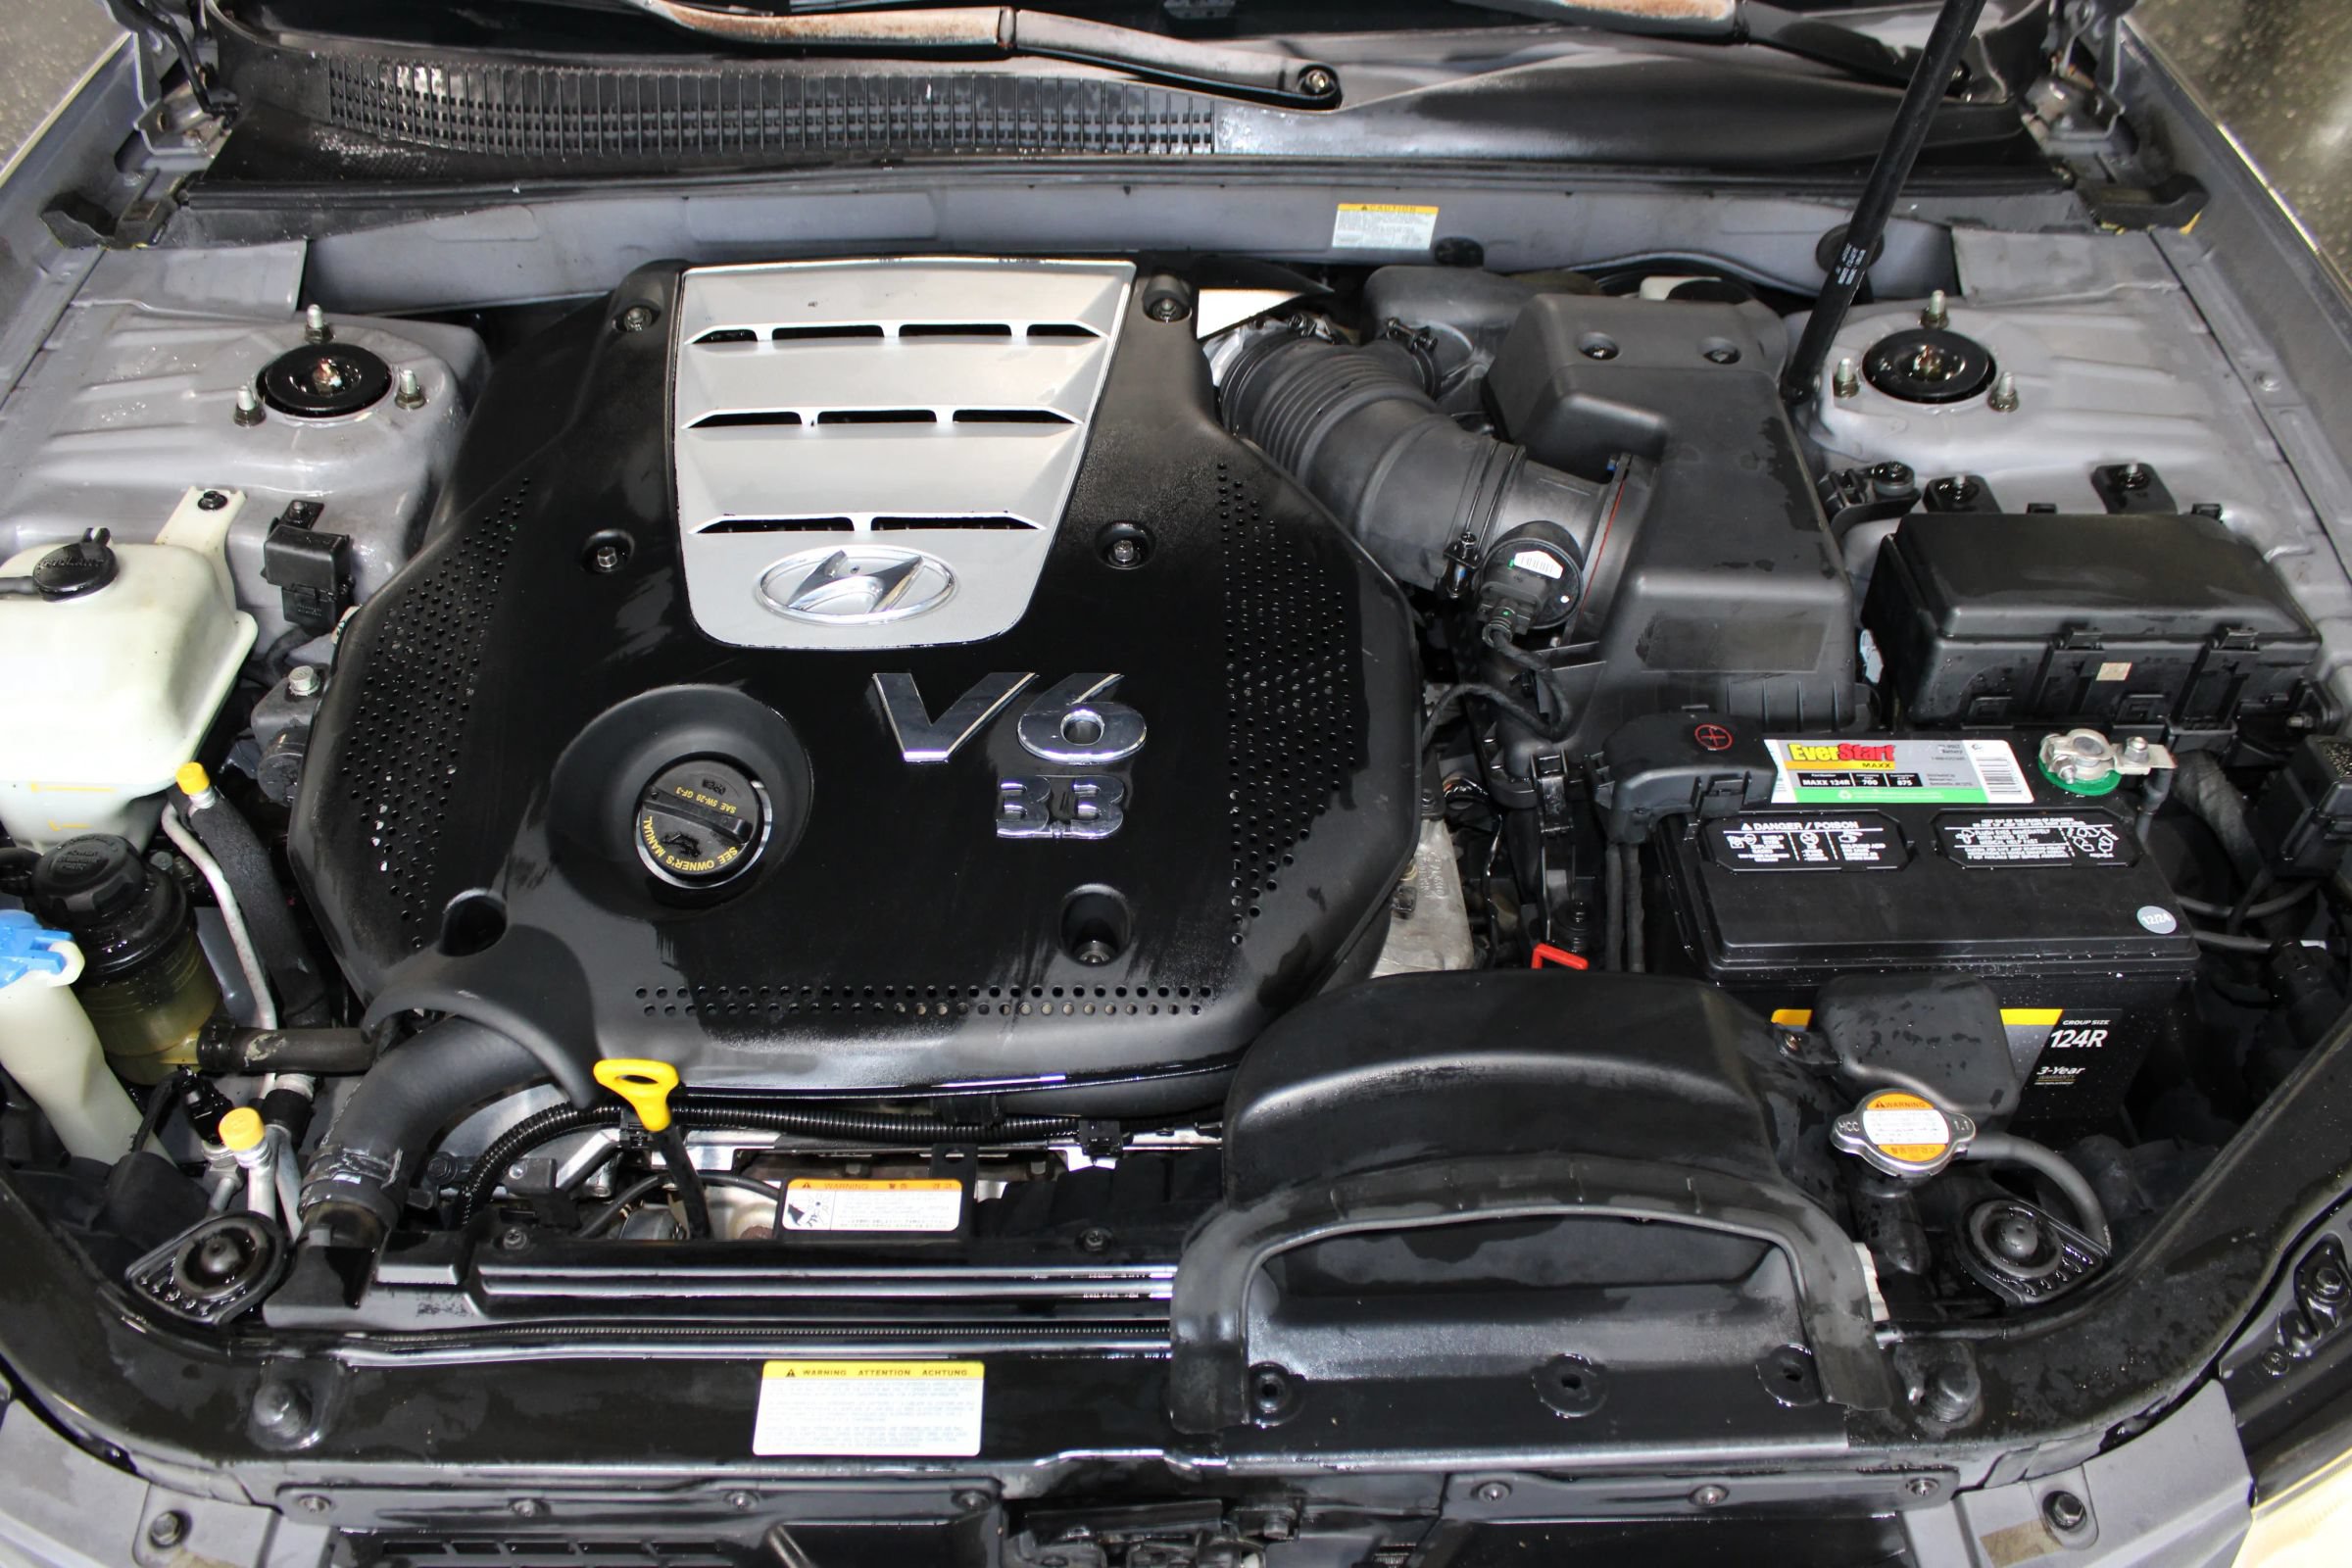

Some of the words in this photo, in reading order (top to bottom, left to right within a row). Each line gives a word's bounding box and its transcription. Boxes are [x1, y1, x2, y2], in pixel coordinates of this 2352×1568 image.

[871, 672, 1148, 765] V6
[1788, 743, 1895, 761] EverStart
[720, 803, 736, 813] SAE
[1752, 822, 1803, 831] DANGER
[1814, 821, 1860, 830] POISON
[643, 815, 666, 858] MANUAL
[717, 846, 738, 864] SEE
[665, 856, 715, 871] OWNER'S
[2050, 1029, 2108, 1049] 124R
[2036, 1065, 2086, 1075] 3-Year
[1838, 1120, 1860, 1133] HCC
[824, 1182, 869, 1191] WARNING
